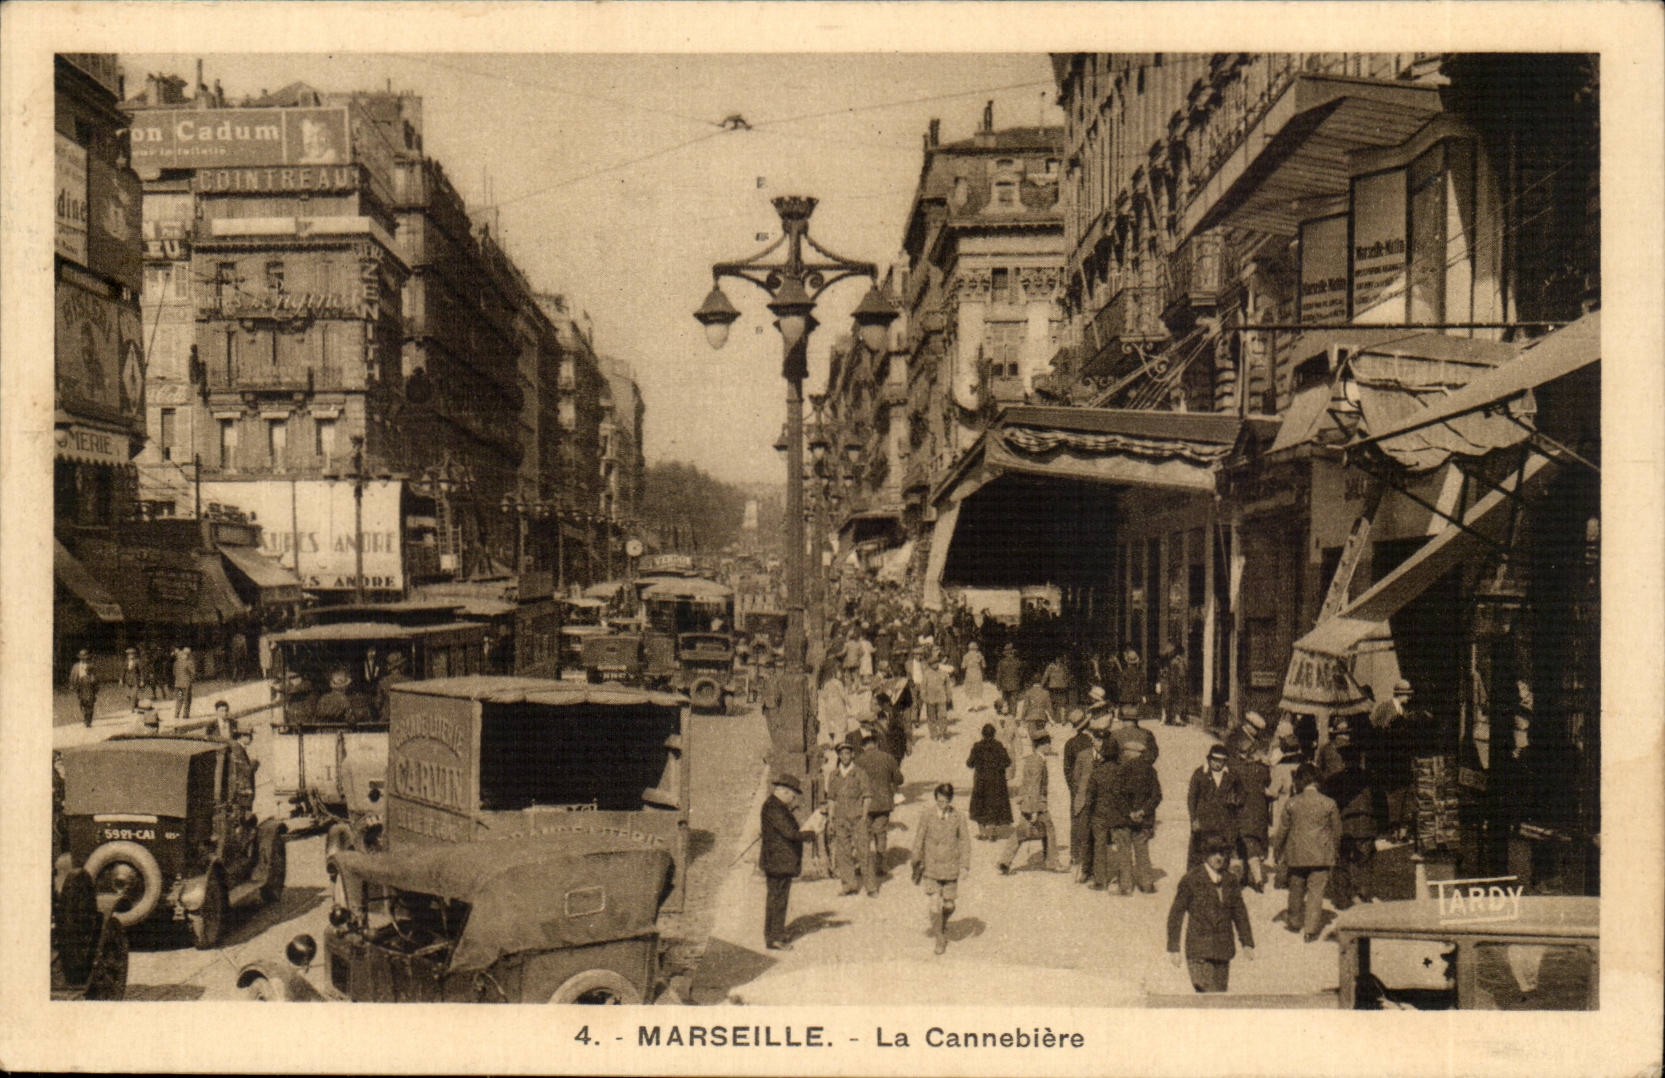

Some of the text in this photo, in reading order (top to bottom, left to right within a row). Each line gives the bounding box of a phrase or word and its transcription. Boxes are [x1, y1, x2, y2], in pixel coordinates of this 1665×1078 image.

[176, 119, 281, 141] Cadum
[198, 168, 348, 191] COINTREAU
[361, 262, 381, 382] ZENITH
[334, 575, 397, 588] ANDRE
